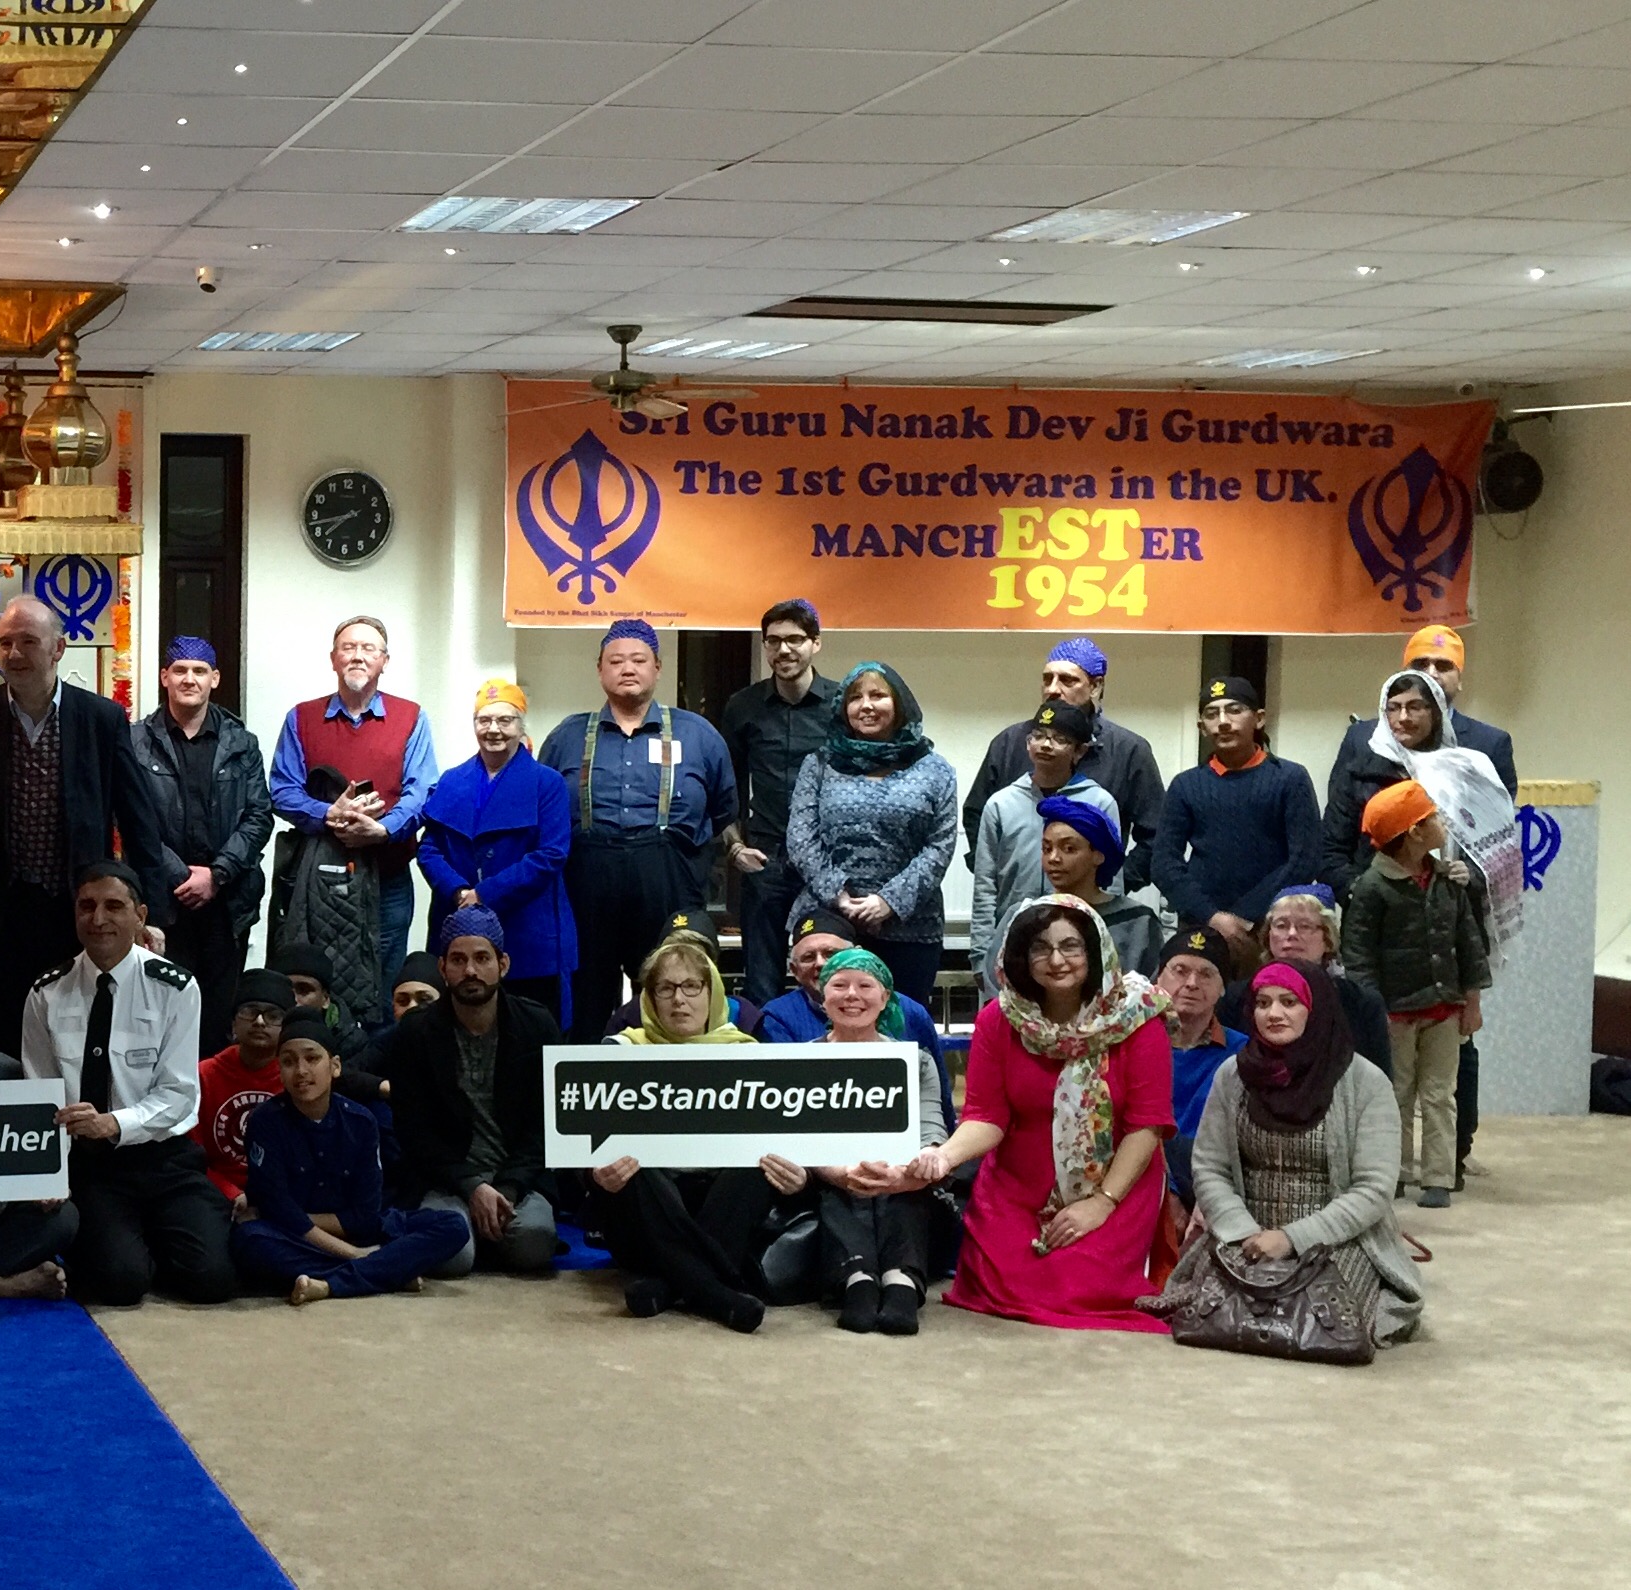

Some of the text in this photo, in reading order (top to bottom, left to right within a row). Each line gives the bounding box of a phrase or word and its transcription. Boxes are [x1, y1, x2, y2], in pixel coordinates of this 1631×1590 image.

[618, 402, 1395, 449] Sri Guru Nanak Dev Ji Gurdwara
[343, 479, 353, 489] 12
[673, 460, 1338, 503] The 1st Gurdwara in the UK.
[329, 482, 336, 492] 11
[361, 484, 366, 494] 1
[315, 494, 325, 504] 10
[371, 497, 378, 507] 2
[311, 510, 319, 520] 9
[374, 513, 382, 523] 3
[315, 527, 322, 537] 8
[369, 529, 376, 539] 4
[326, 539, 333, 549] 7
[341, 544, 348, 554] 6
[357, 540, 364, 551] 5
[986, 563, 1148, 617] 1954
[560, 1079, 903, 1117] #WeStandTogether
